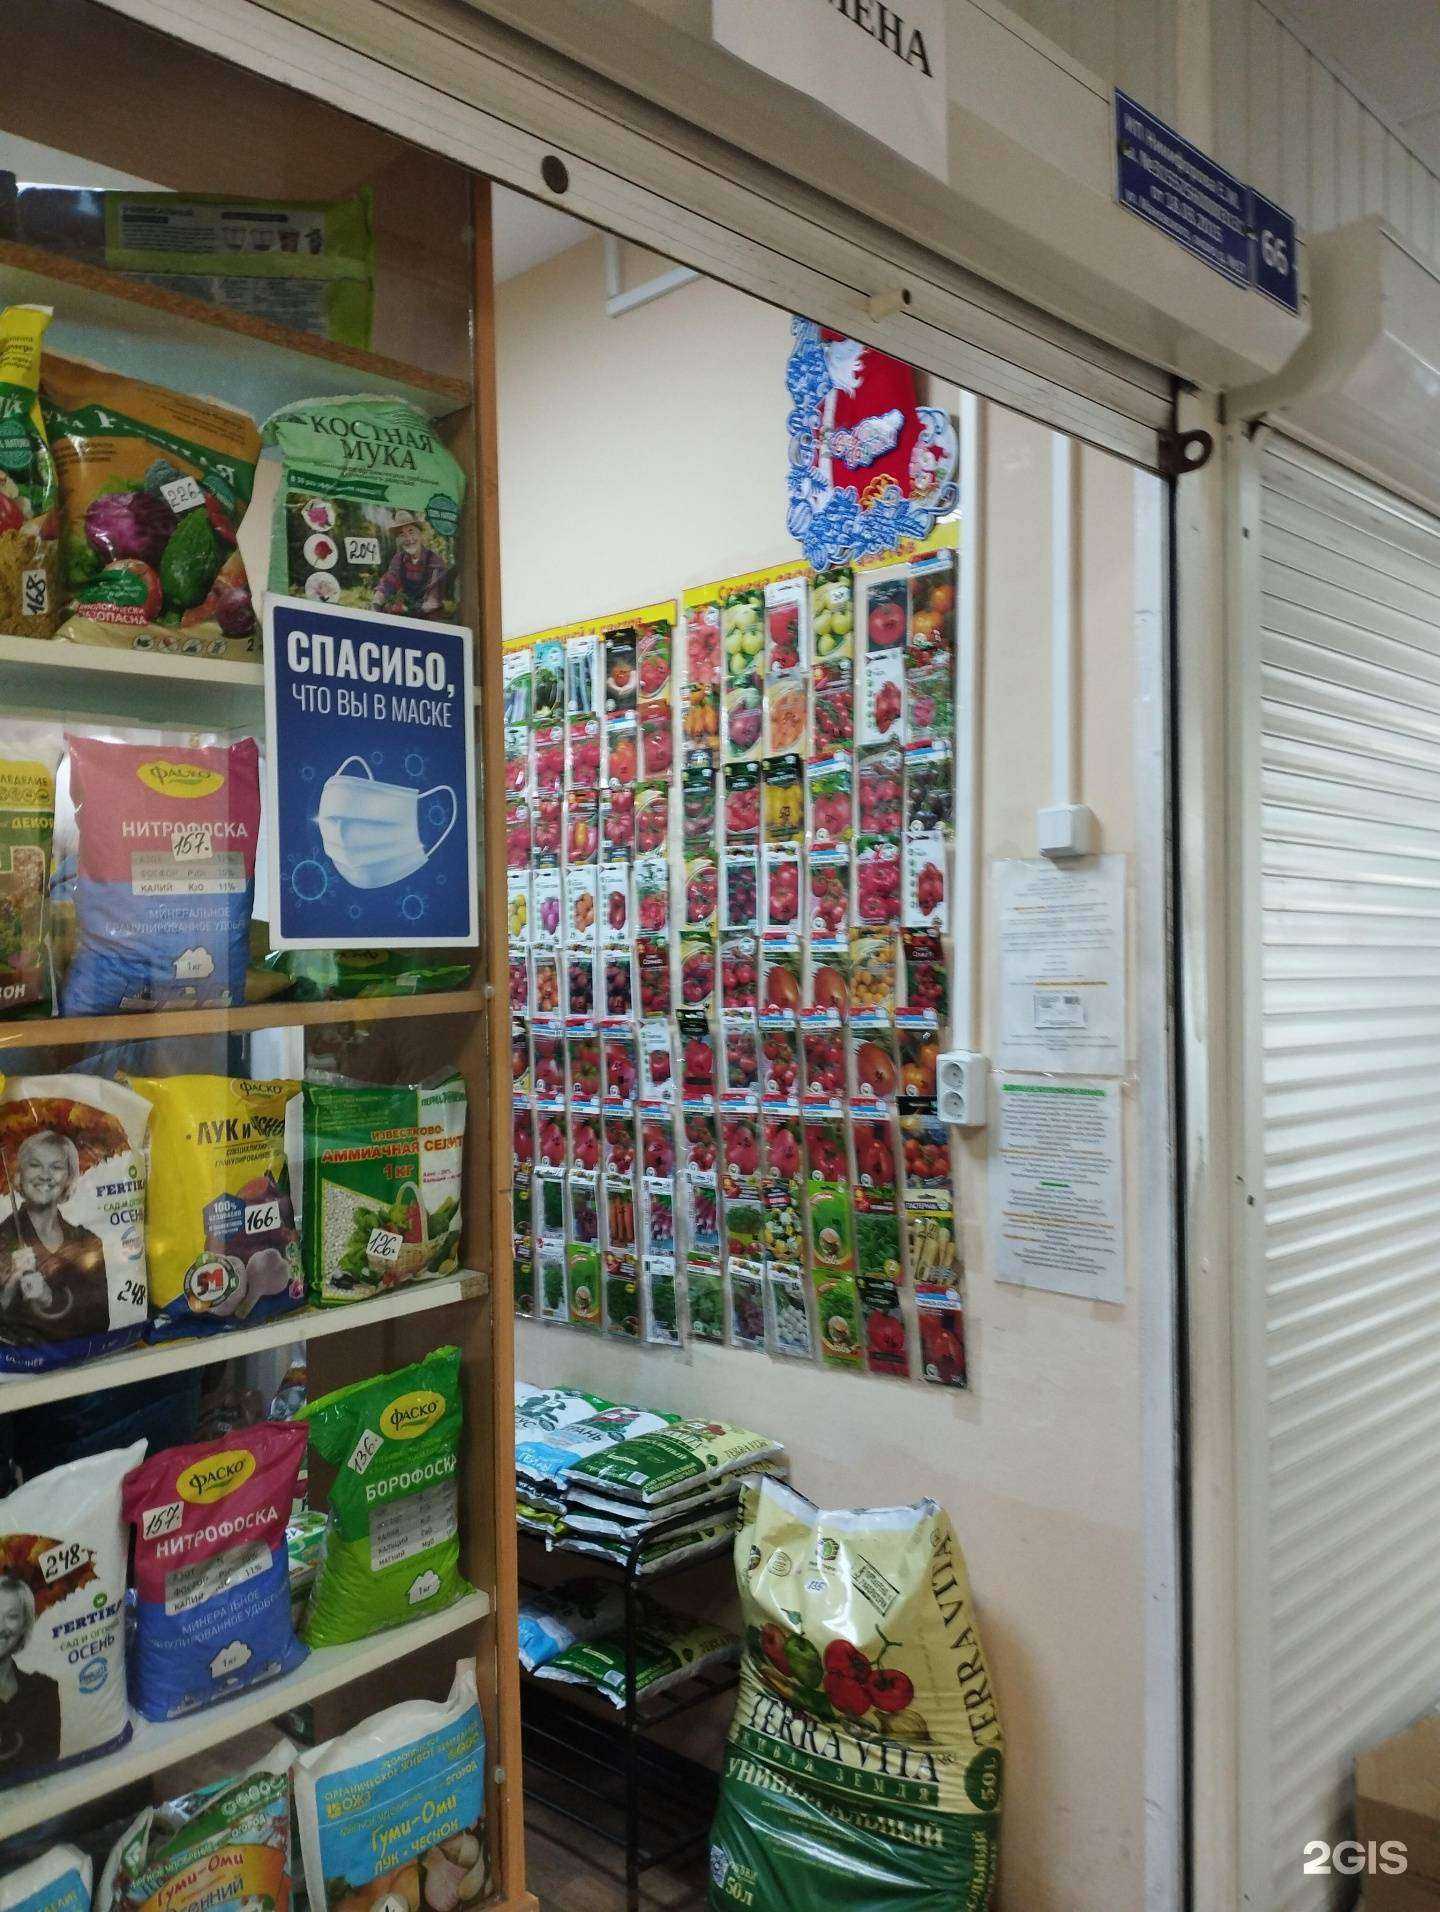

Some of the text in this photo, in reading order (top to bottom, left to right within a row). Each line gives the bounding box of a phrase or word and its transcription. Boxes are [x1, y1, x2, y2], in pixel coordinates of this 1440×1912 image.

[829, 0, 934, 78] ЕНА
[310, 416, 434, 453] КОСТНАЯ
[340, 439, 417, 470] МУКА
[287, 630, 455, 698] СПАСИБО,
[292, 683, 452, 728] ЧТО ВЫ В МАСКЕ
[122, 821, 248, 838] НИТРОФОСКА
[197, 1119, 239, 1145] ЛУК
[322, 1137, 420, 1163] АММИАЧНАЯ
[390, 1402, 437, 1432] ФАСКО
[189, 1460, 243, 1495] ФАСКО
[366, 1453, 457, 1503] БОРОФОСКА
[156, 1506, 278, 1559] НИТРОФОСКА
[69, 1633, 114, 1664] ОСЕНЬ
[411, 1817, 459, 1851] ЧЕСНОК
